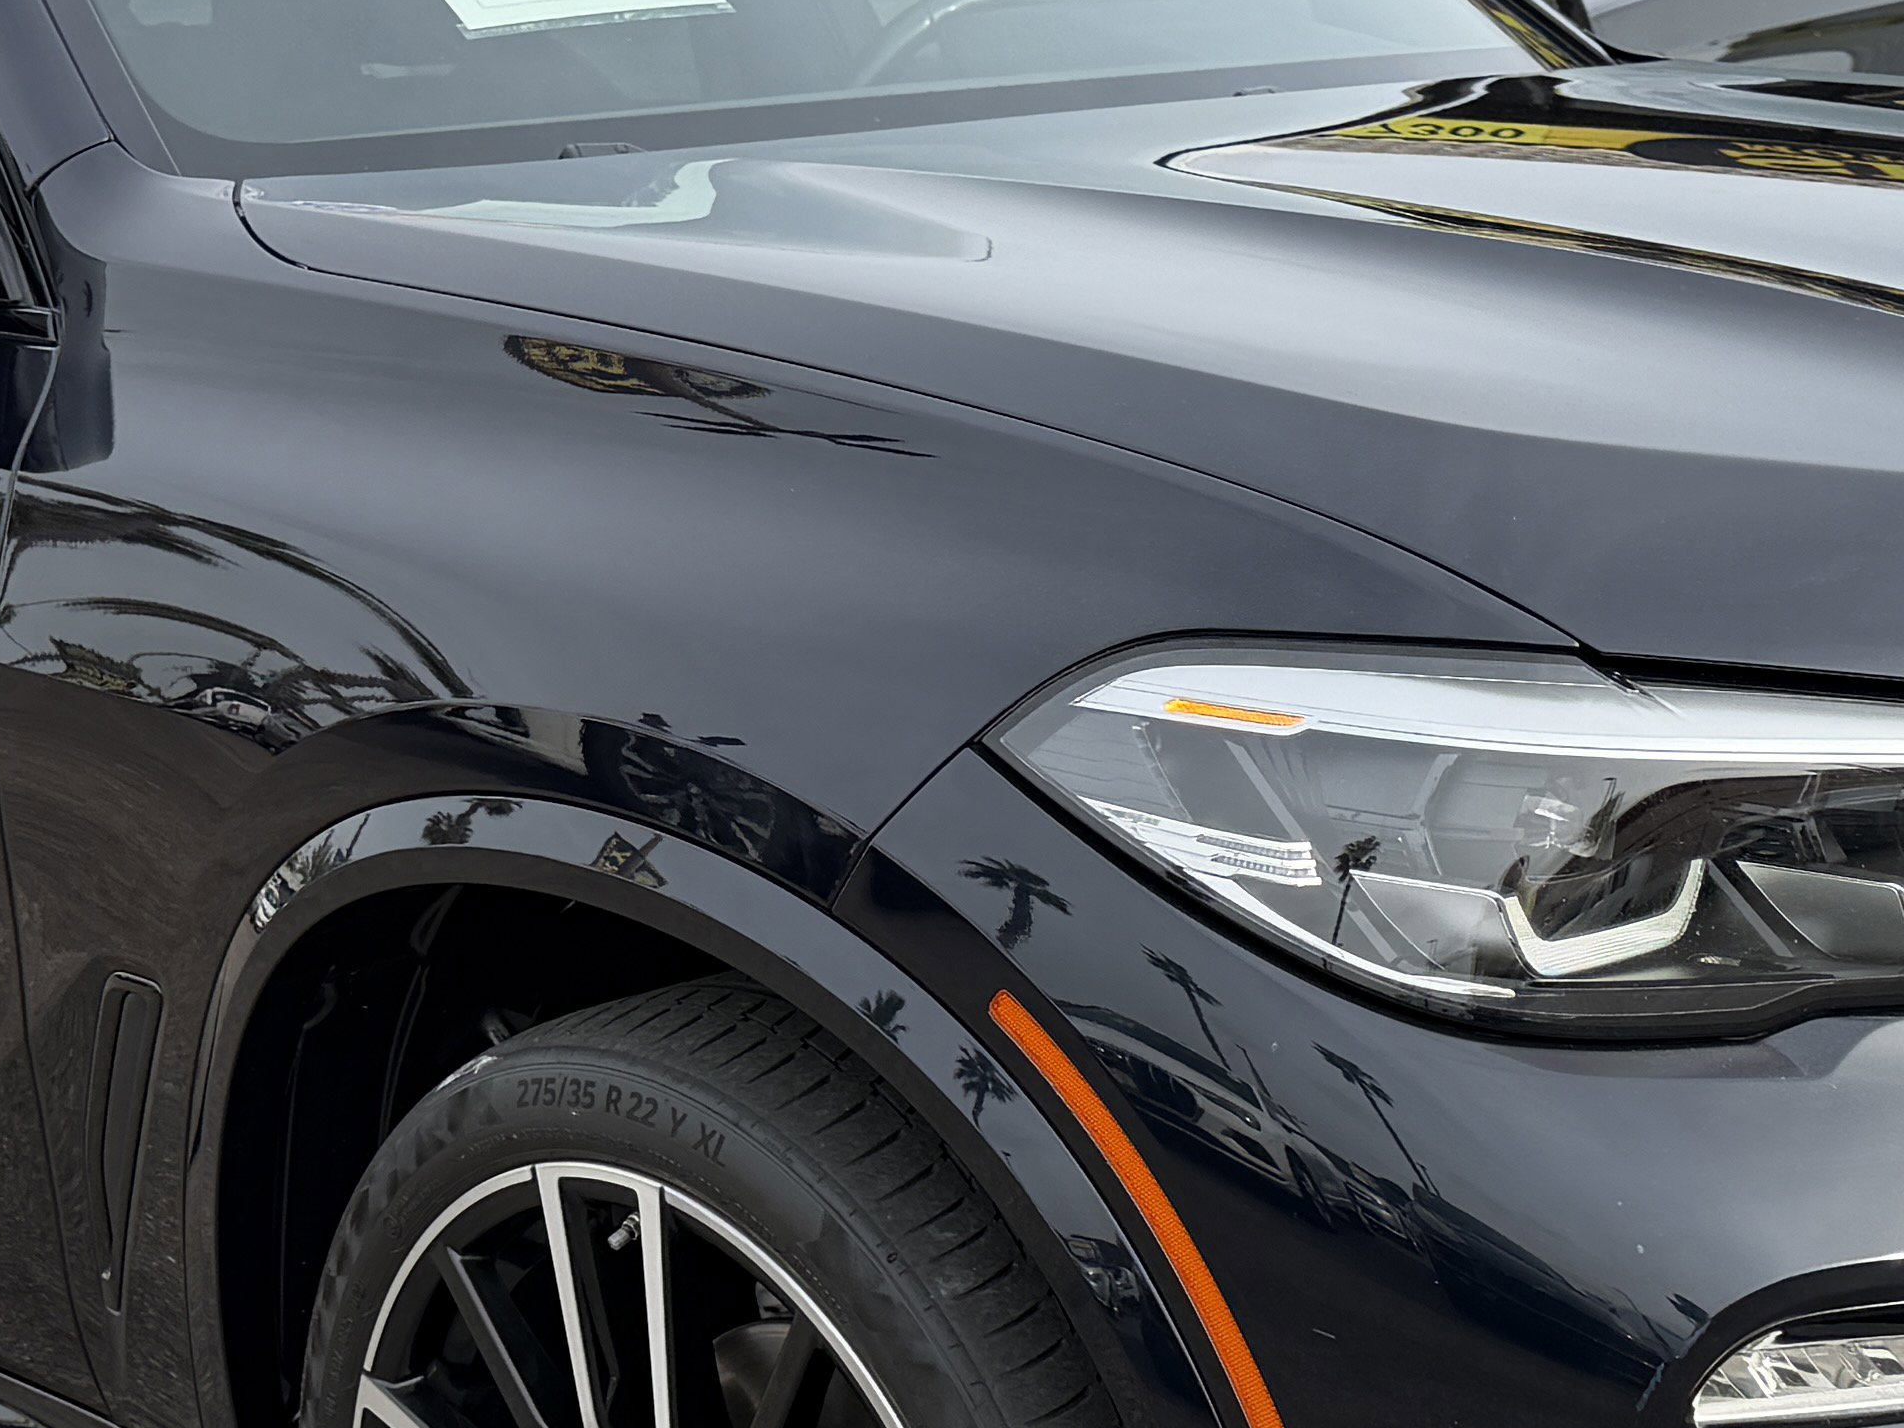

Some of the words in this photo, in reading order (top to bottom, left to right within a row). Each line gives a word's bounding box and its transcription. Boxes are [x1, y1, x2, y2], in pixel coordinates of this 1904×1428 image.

[516, 1075, 597, 1110] 275/35
[669, 1106, 688, 1139] Y
[692, 1121, 727, 1169] XL
